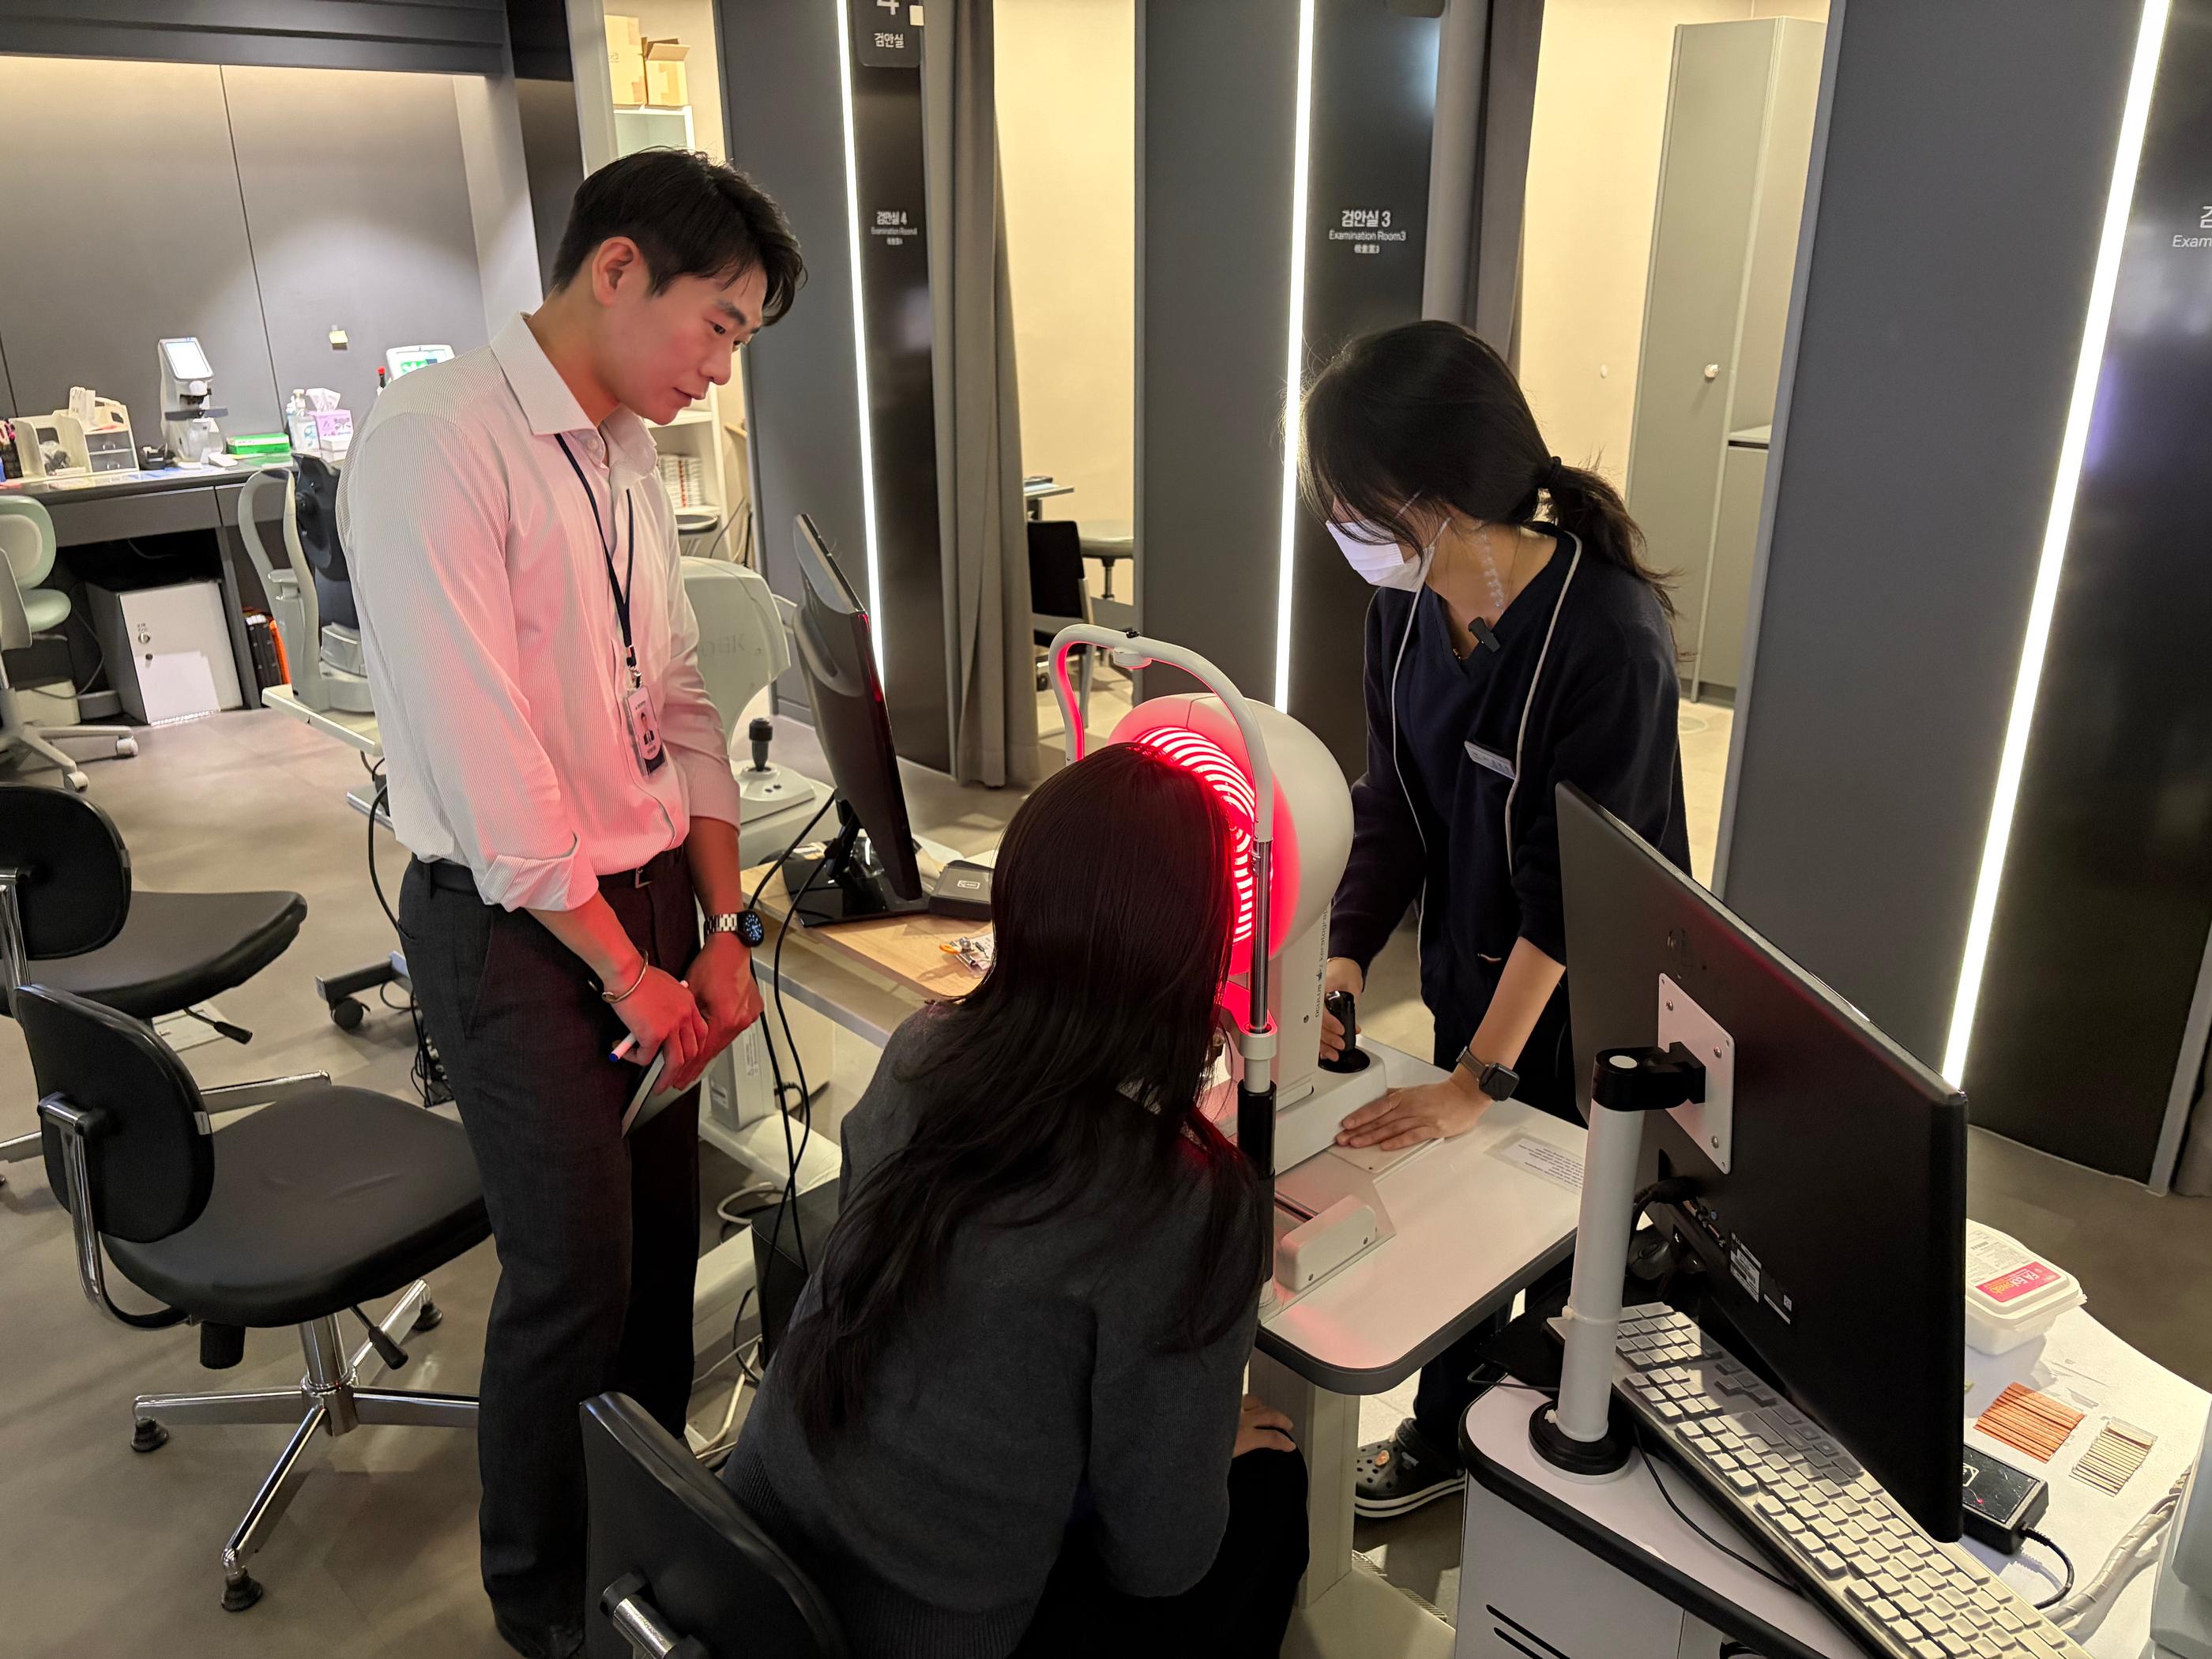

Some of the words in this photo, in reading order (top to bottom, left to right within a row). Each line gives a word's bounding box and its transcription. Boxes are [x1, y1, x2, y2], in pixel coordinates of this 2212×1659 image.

[874, 32, 905, 48] 검안실
[1341, 209, 1379, 228] 검안실
[1381, 211, 1391, 228] 3
[1329, 230, 1376, 240] Examination
[1377, 230, 1406, 241] Room3
